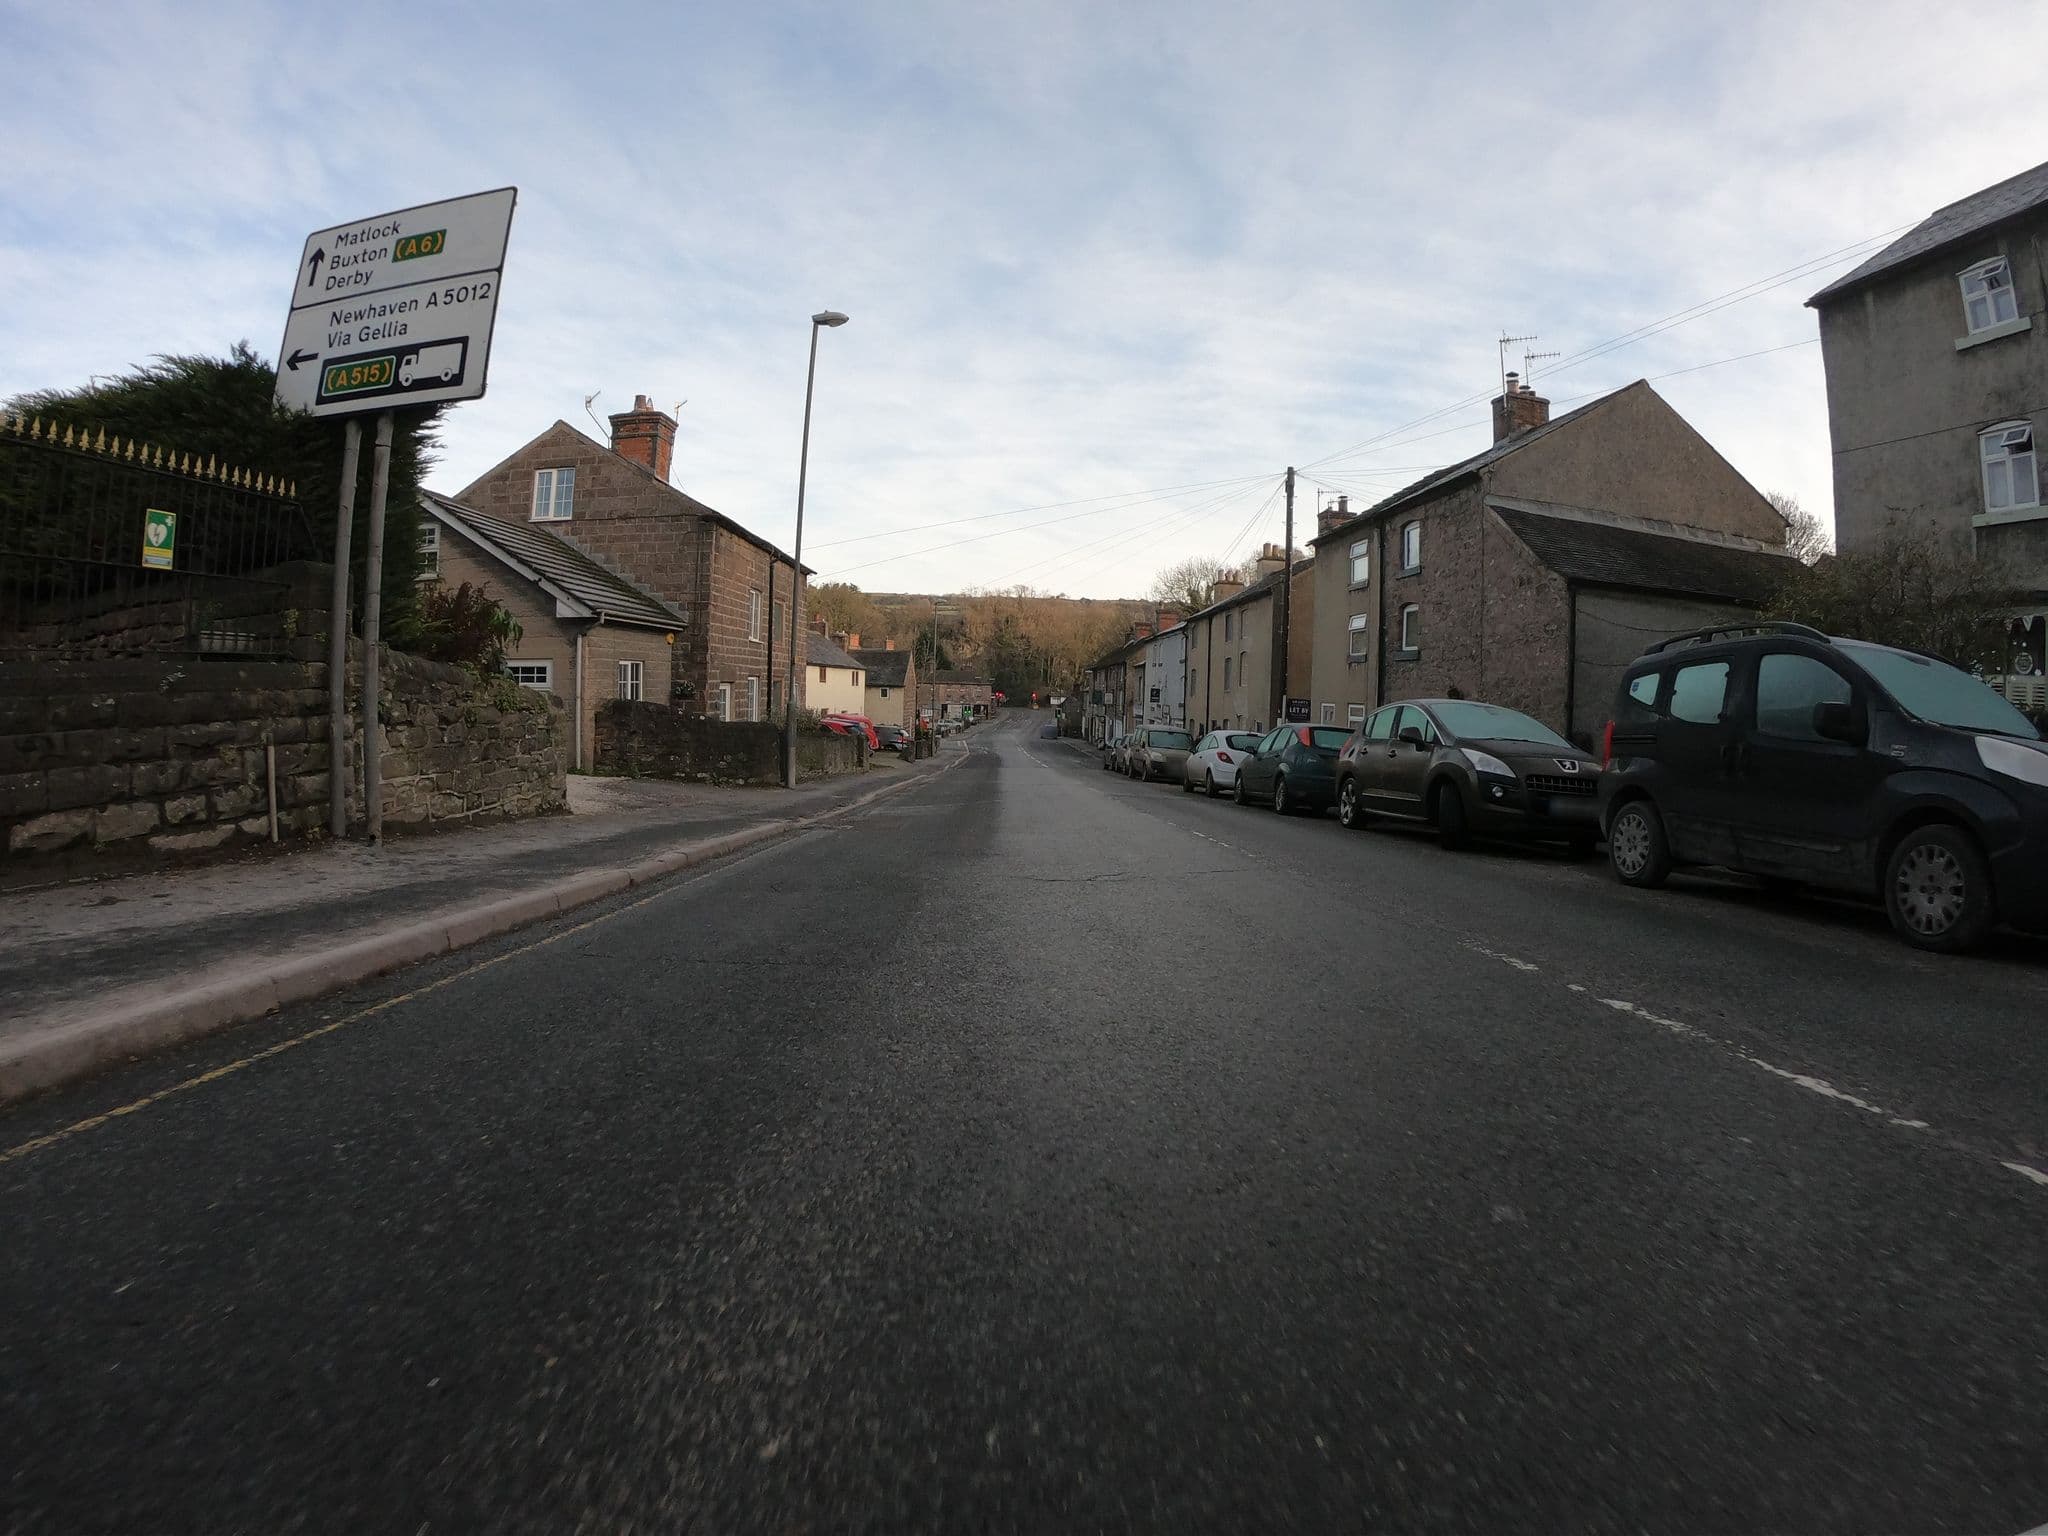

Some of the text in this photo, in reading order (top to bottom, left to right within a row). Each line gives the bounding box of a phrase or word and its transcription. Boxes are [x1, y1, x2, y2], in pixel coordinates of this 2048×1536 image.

[334, 221, 401, 249] Matlock
[330, 248, 388, 270] Buxton
[325, 270, 374, 291] Derby
[329, 299, 419, 327] Newhaven
[327, 321, 408, 348] Via Gellia
